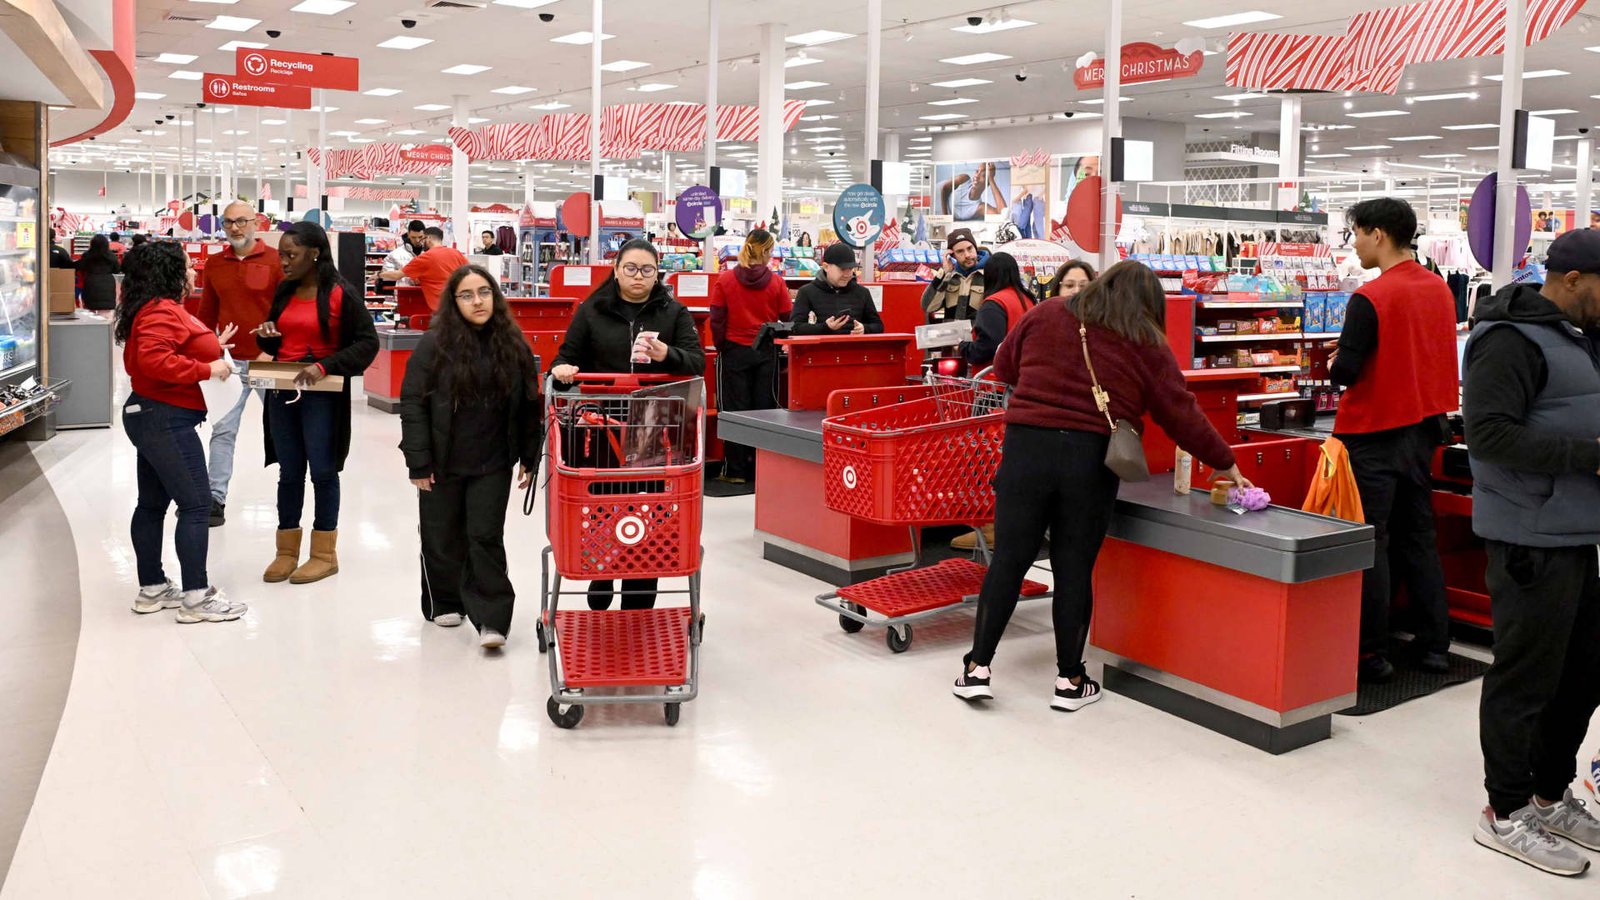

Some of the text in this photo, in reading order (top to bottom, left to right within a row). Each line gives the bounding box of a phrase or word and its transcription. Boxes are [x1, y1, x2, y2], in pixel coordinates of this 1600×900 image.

[270, 59, 314, 72] Recycling
[1084, 56, 1191, 81] MER CHRISTMAS
[232, 83, 275, 93] Restrooms
[407, 151, 429, 159] MERRY
[1231, 144, 1280, 159] Fitting Rooms
[1512, 270, 1534, 286] entos
